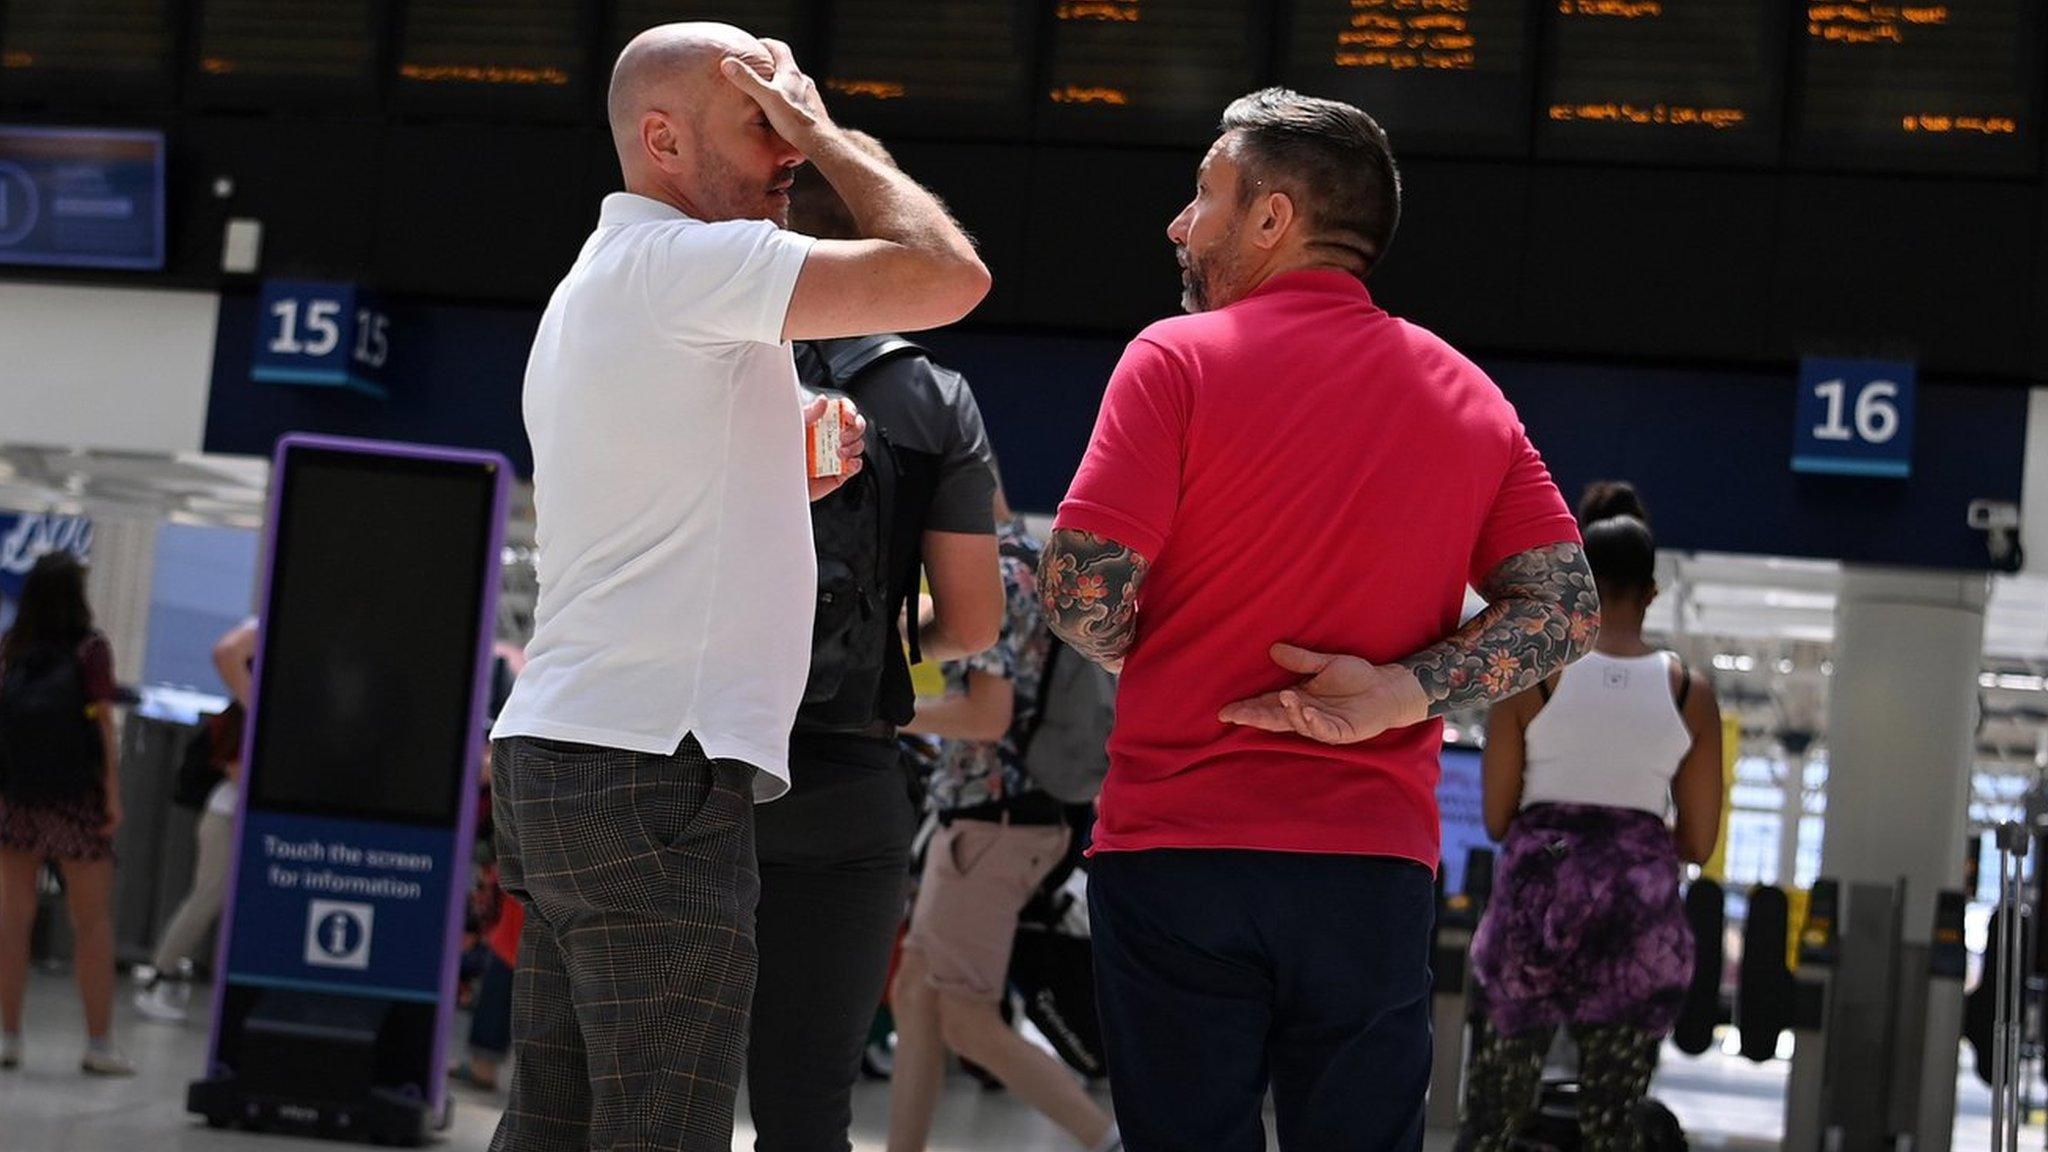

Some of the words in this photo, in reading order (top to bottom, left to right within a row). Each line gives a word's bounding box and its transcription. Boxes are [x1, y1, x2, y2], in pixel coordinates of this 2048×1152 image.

[270, 299, 341, 357] 15
[355, 309, 389, 368] 15
[1813, 379, 1900, 444] 16
[265, 834, 325, 862] Touch
[327, 842, 363, 867] the
[365, 849, 433, 872] screen
[268, 864, 298, 888] for
[303, 868, 421, 899] information
